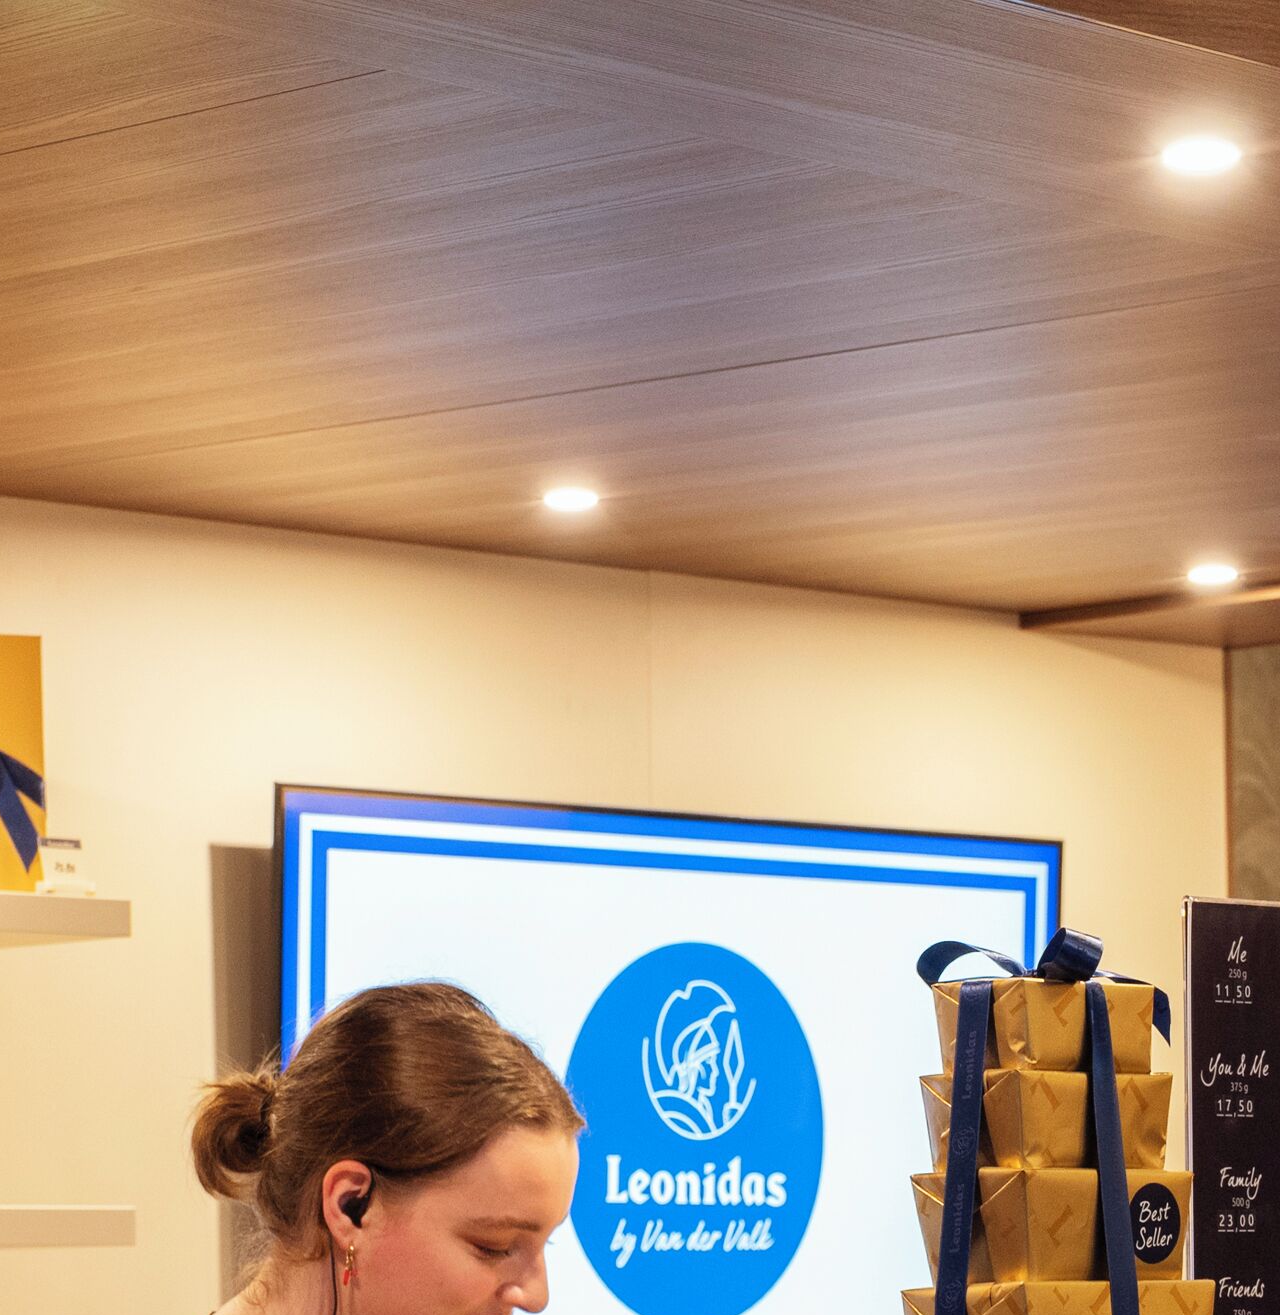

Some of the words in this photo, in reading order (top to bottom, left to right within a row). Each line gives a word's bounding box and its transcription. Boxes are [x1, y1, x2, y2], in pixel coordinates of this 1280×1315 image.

[1227, 936, 1247, 963] Me
[1228, 968, 1241, 979] 250
[1201, 1053, 1232, 1087] You
[1236, 1053, 1246, 1077] &
[1249, 1050, 1270, 1079] Me
[1230, 1081, 1242, 1093] 375
[606, 1154, 787, 1207] Leonidas
[1220, 1166, 1262, 1200] Family
[1139, 1200, 1171, 1223] Best
[1232, 1197, 1243, 1208] 500
[610, 1218, 637, 1269] by
[640, 1218, 685, 1252] Van
[686, 1220, 722, 1252] der
[723, 1218, 775, 1252] Valk
[1136, 1226, 1173, 1250] Seller
[1218, 1276, 1265, 1299] Friends
